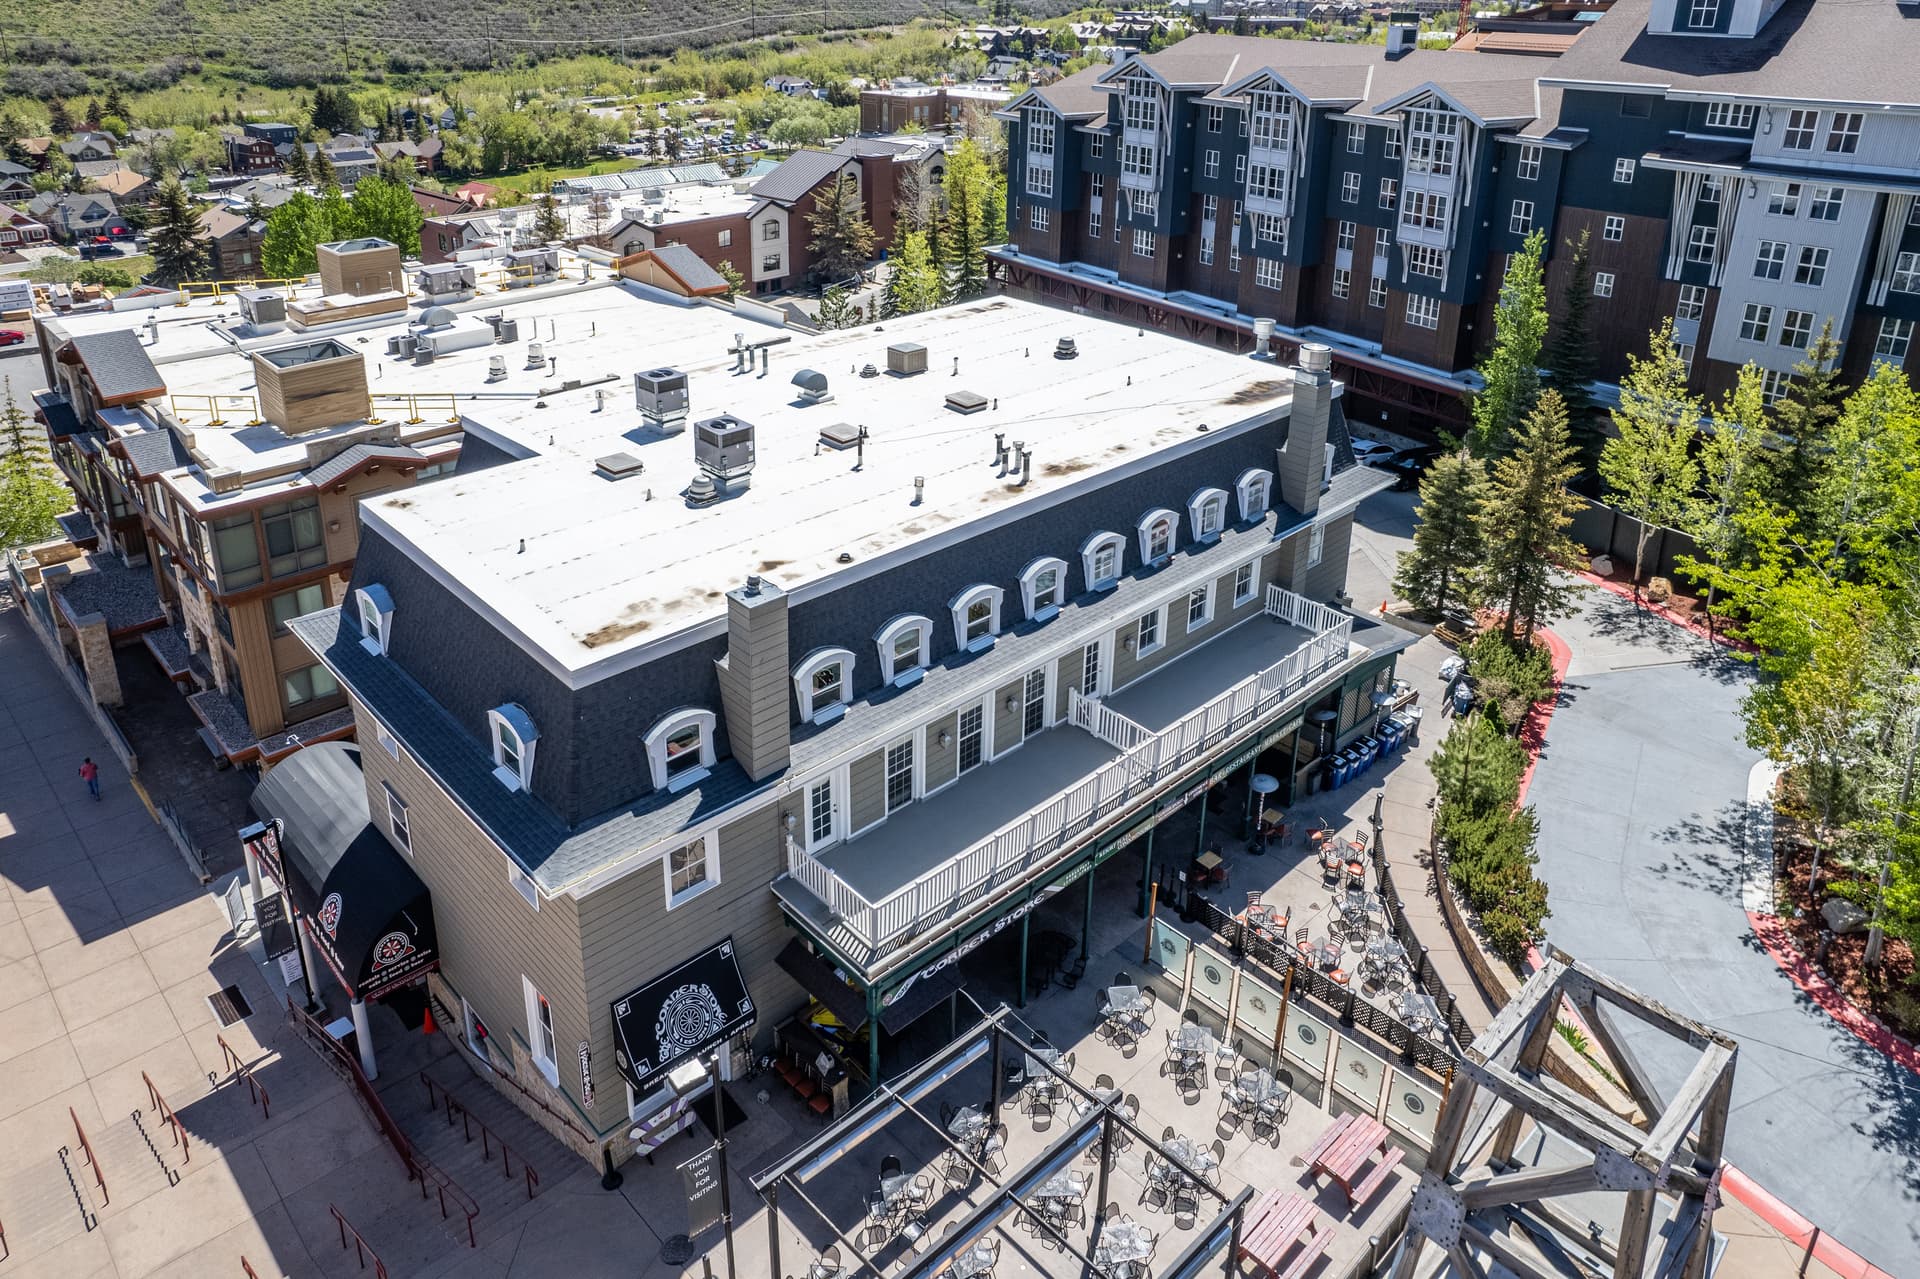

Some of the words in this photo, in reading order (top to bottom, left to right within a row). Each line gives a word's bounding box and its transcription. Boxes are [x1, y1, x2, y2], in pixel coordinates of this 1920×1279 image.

[921, 929, 991, 980] CORNER
[994, 893, 1046, 933] STORE
[697, 1038, 722, 1057] LUNCH
[688, 1152, 713, 1171] THANK
[694, 1165, 710, 1179] YOU
[689, 1180, 718, 1201] VISITING
[695, 1175, 711, 1189] FOR
